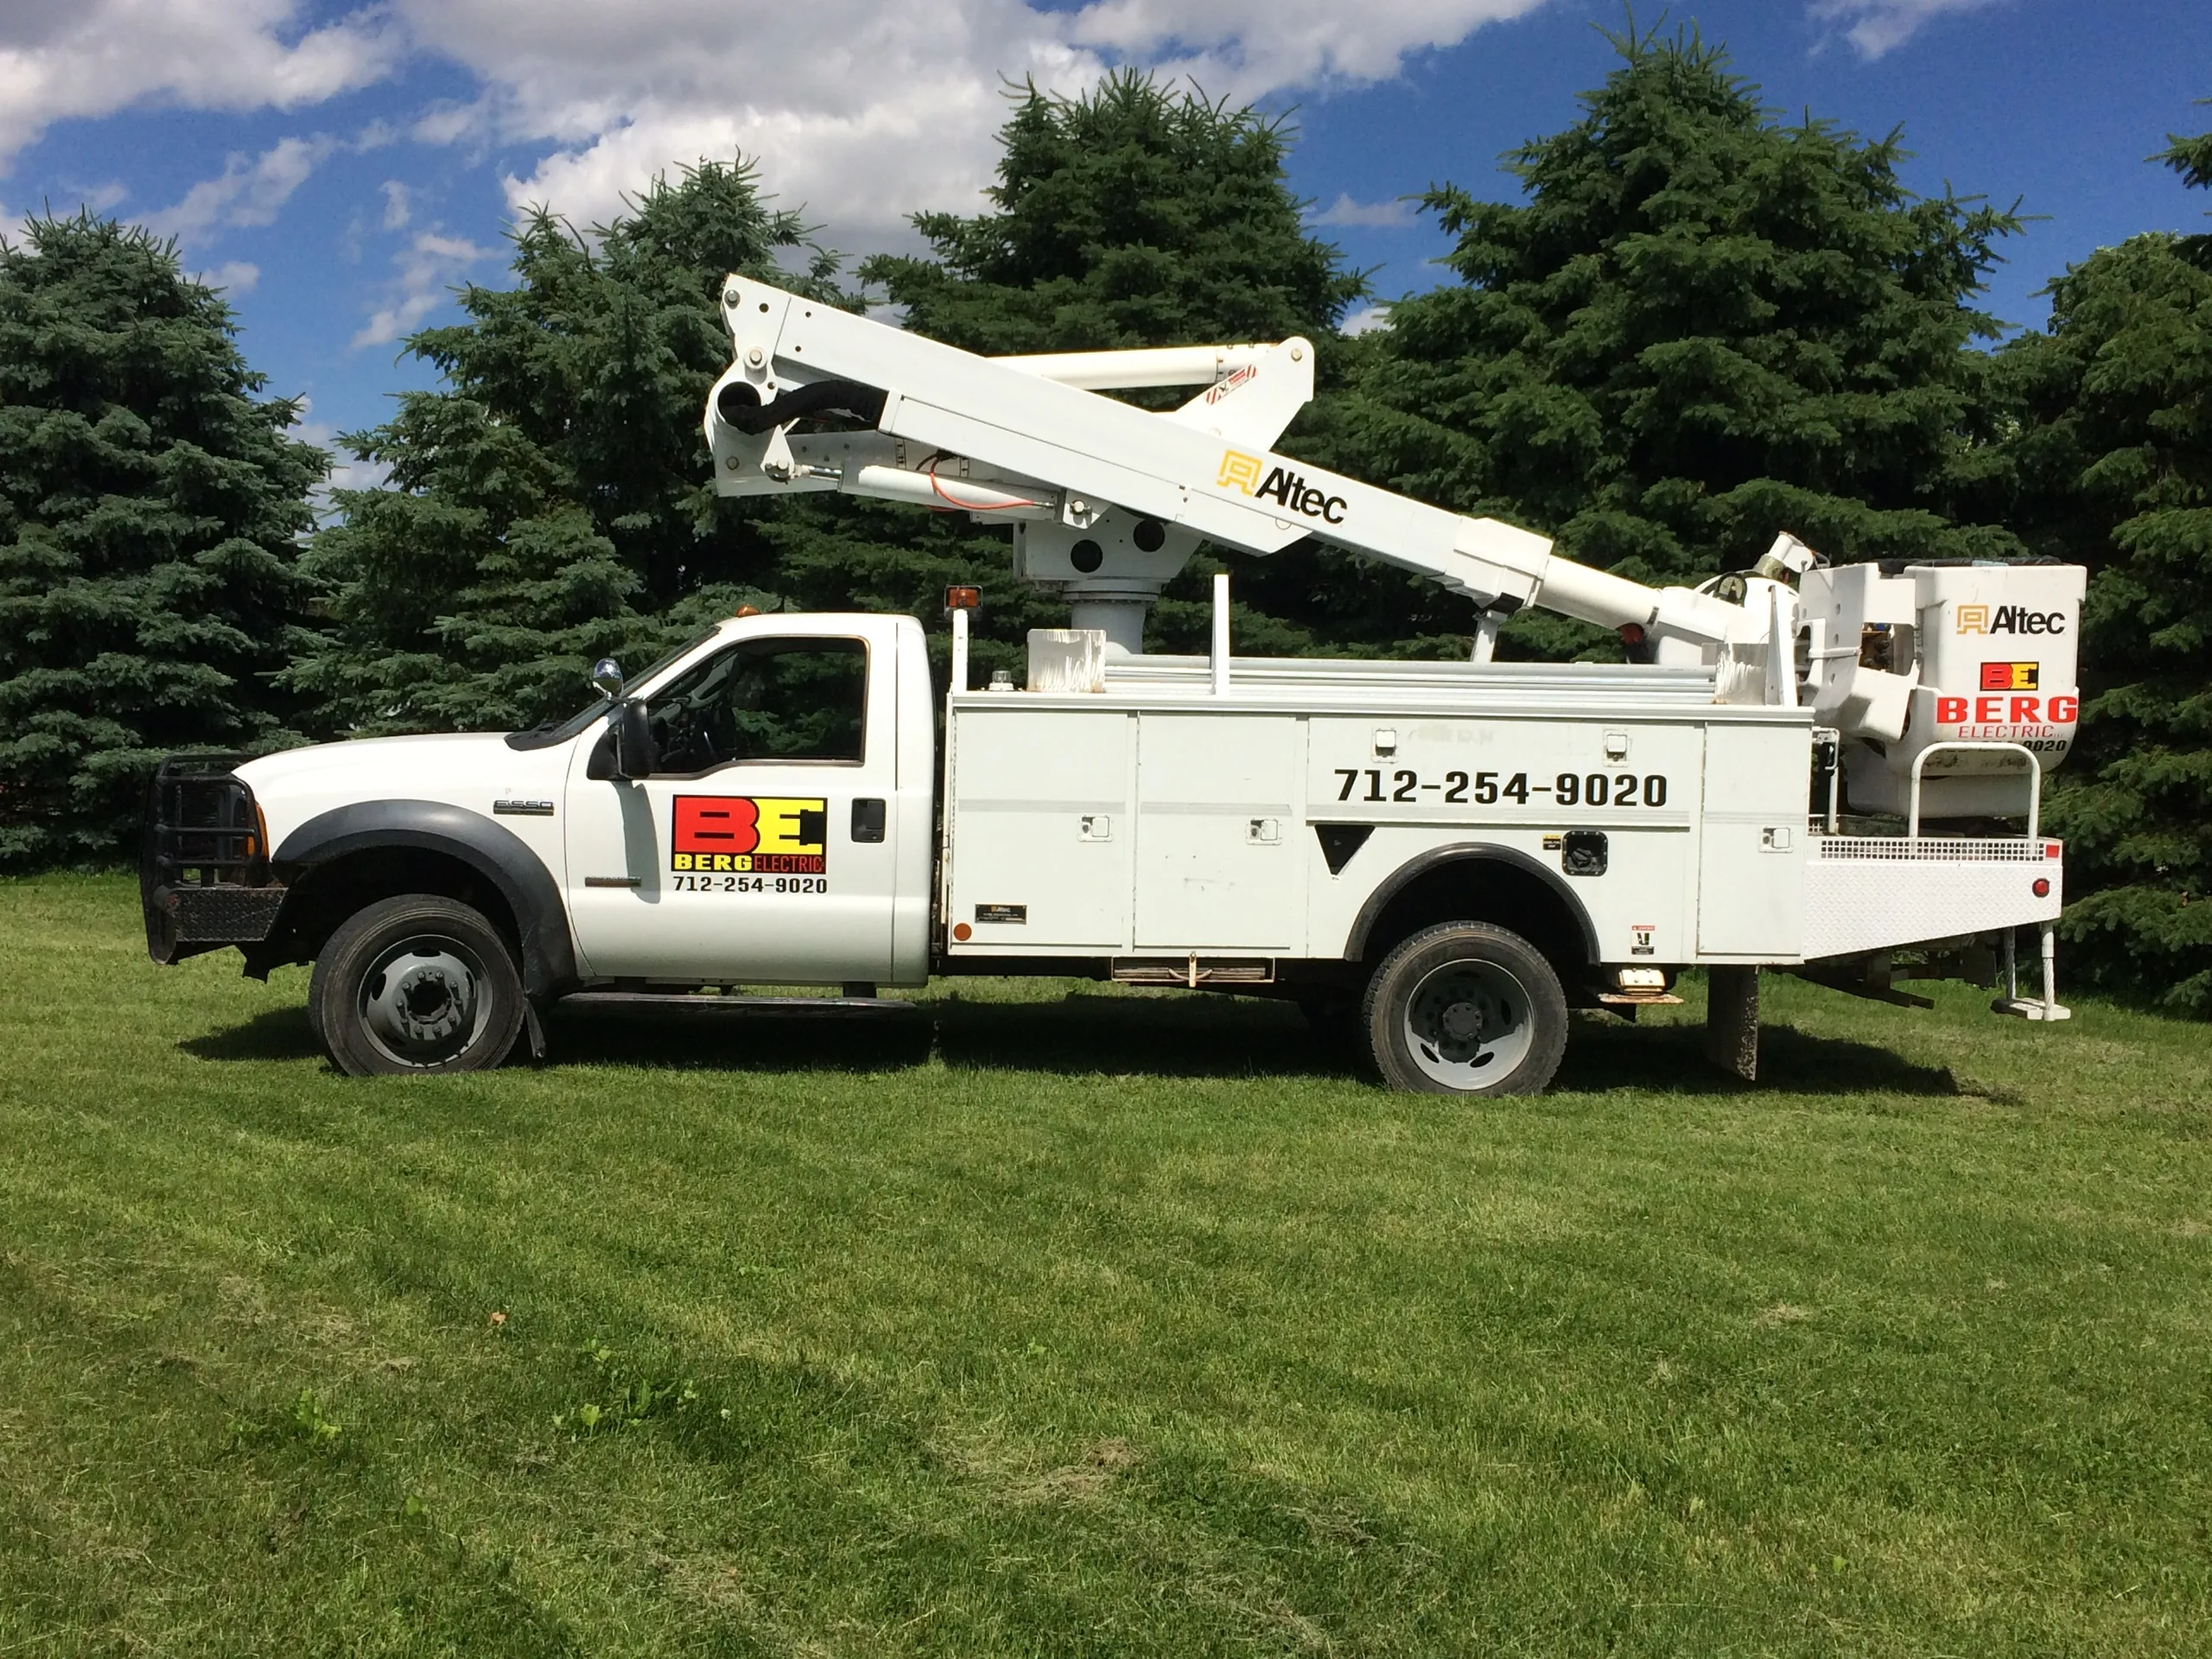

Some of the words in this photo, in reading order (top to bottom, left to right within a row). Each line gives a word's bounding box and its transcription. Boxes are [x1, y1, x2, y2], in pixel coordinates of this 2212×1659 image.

[1255, 467, 1348, 524] Altec
[1990, 606, 2066, 634] Altec
[1981, 664, 2037, 690] BE
[1936, 696, 2078, 723] BERG
[1958, 725, 2055, 739] ELECTRIC
[1334, 768, 1668, 808] 712-254-9020
[675, 798, 824, 855] BE
[674, 854, 753, 871] BERG
[753, 855, 823, 873] ELECTRIC
[672, 876, 827, 893] 712-254-9020
